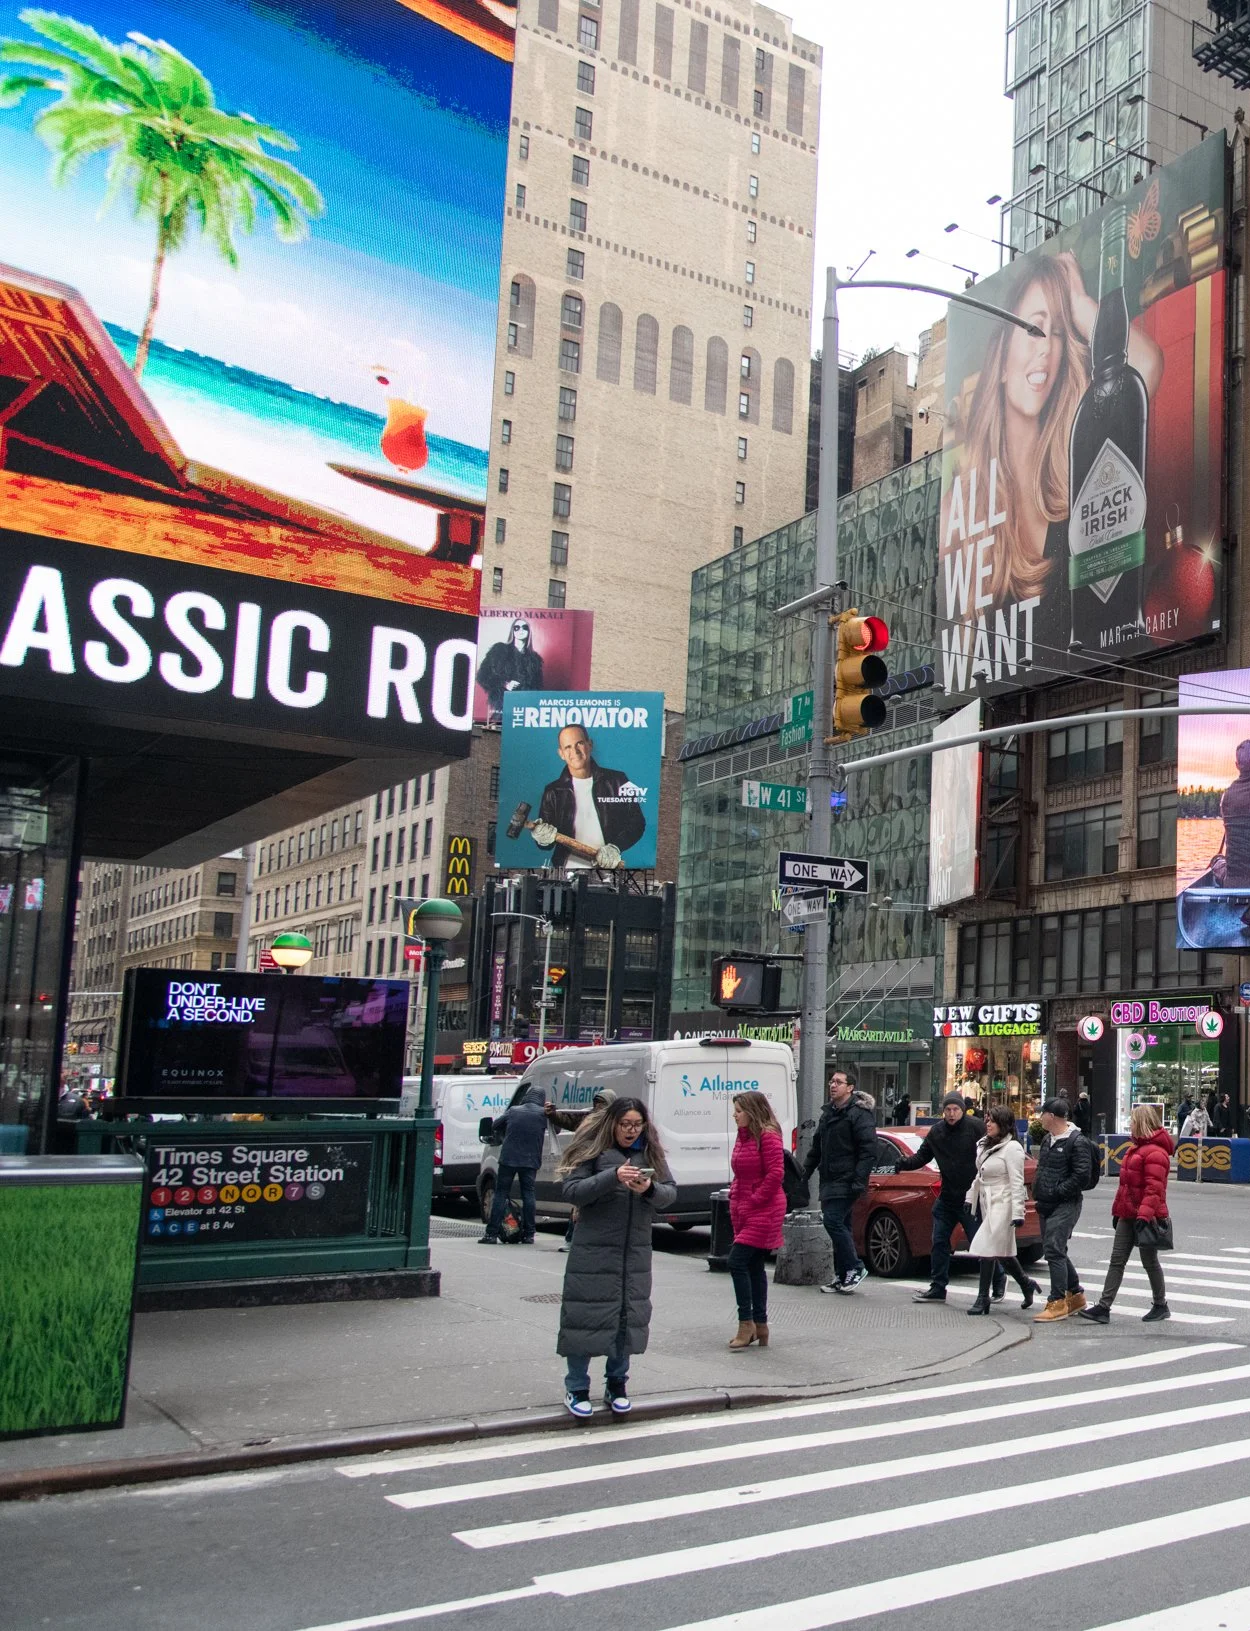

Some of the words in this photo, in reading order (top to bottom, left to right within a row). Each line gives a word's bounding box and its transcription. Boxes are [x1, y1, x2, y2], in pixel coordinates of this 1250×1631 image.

[944, 458, 1007, 548] ALL
[1081, 486, 1132, 520] BLACK
[1085, 506, 1127, 536] IRISH
[944, 535, 995, 620] WE
[479, 609, 522, 619] ALBERTO
[1145, 608, 1180, 635] CAREY
[0, 565, 331, 709] ASSIC
[942, 595, 1040, 696] WANT
[539, 699, 574, 707] MARCUS
[576, 699, 612, 707] LEMONIS
[614, 699, 621, 707] IS
[797, 697, 803, 716] 7
[512, 706, 524, 728] THE
[524, 706, 649, 728] RENOVATOR
[781, 725, 806, 747] Fashion
[618, 786, 648, 796] HGTV
[761, 786, 772, 806] W
[777, 788, 791, 808] 41
[797, 790, 805, 803] St
[792, 863, 818, 878] ONE
[830, 866, 857, 882] WAY
[787, 902, 802, 916] ONE
[806, 898, 821, 913] WAY
[169, 981, 221, 996] DON'T
[168, 994, 266, 1011] UNDER-LIVE
[166, 1007, 180, 1020] A
[183, 1008, 256, 1023] SECOND.
[933, 1005, 975, 1021] NEW
[978, 1003, 1041, 1023] GIFTS
[1111, 1002, 1144, 1025] CBD
[838, 1026, 914, 1043] MARGARITAVILLE
[978, 1023, 1040, 1036] LUGGAGE
[162, 1068, 224, 1078] EQUINOX
[699, 1074, 759, 1092] Alliance
[481, 1094, 512, 1107] Allia
[674, 1108, 711, 1116] Alliance.us
[155, 1147, 222, 1166] Times
[232, 1146, 309, 1167] Square
[152, 1168, 183, 1187] 42
[192, 1166, 260, 1186] Street
[269, 1165, 344, 1185] Station
[165, 1207, 202, 1217] Elevator
[206, 1207, 216, 1215] at
[219, 1206, 231, 1215] 42
[234, 1205, 246, 1214] St
[200, 1221, 210, 1230] at
[213, 1221, 220, 1230] 8
[223, 1221, 235, 1229] Av
